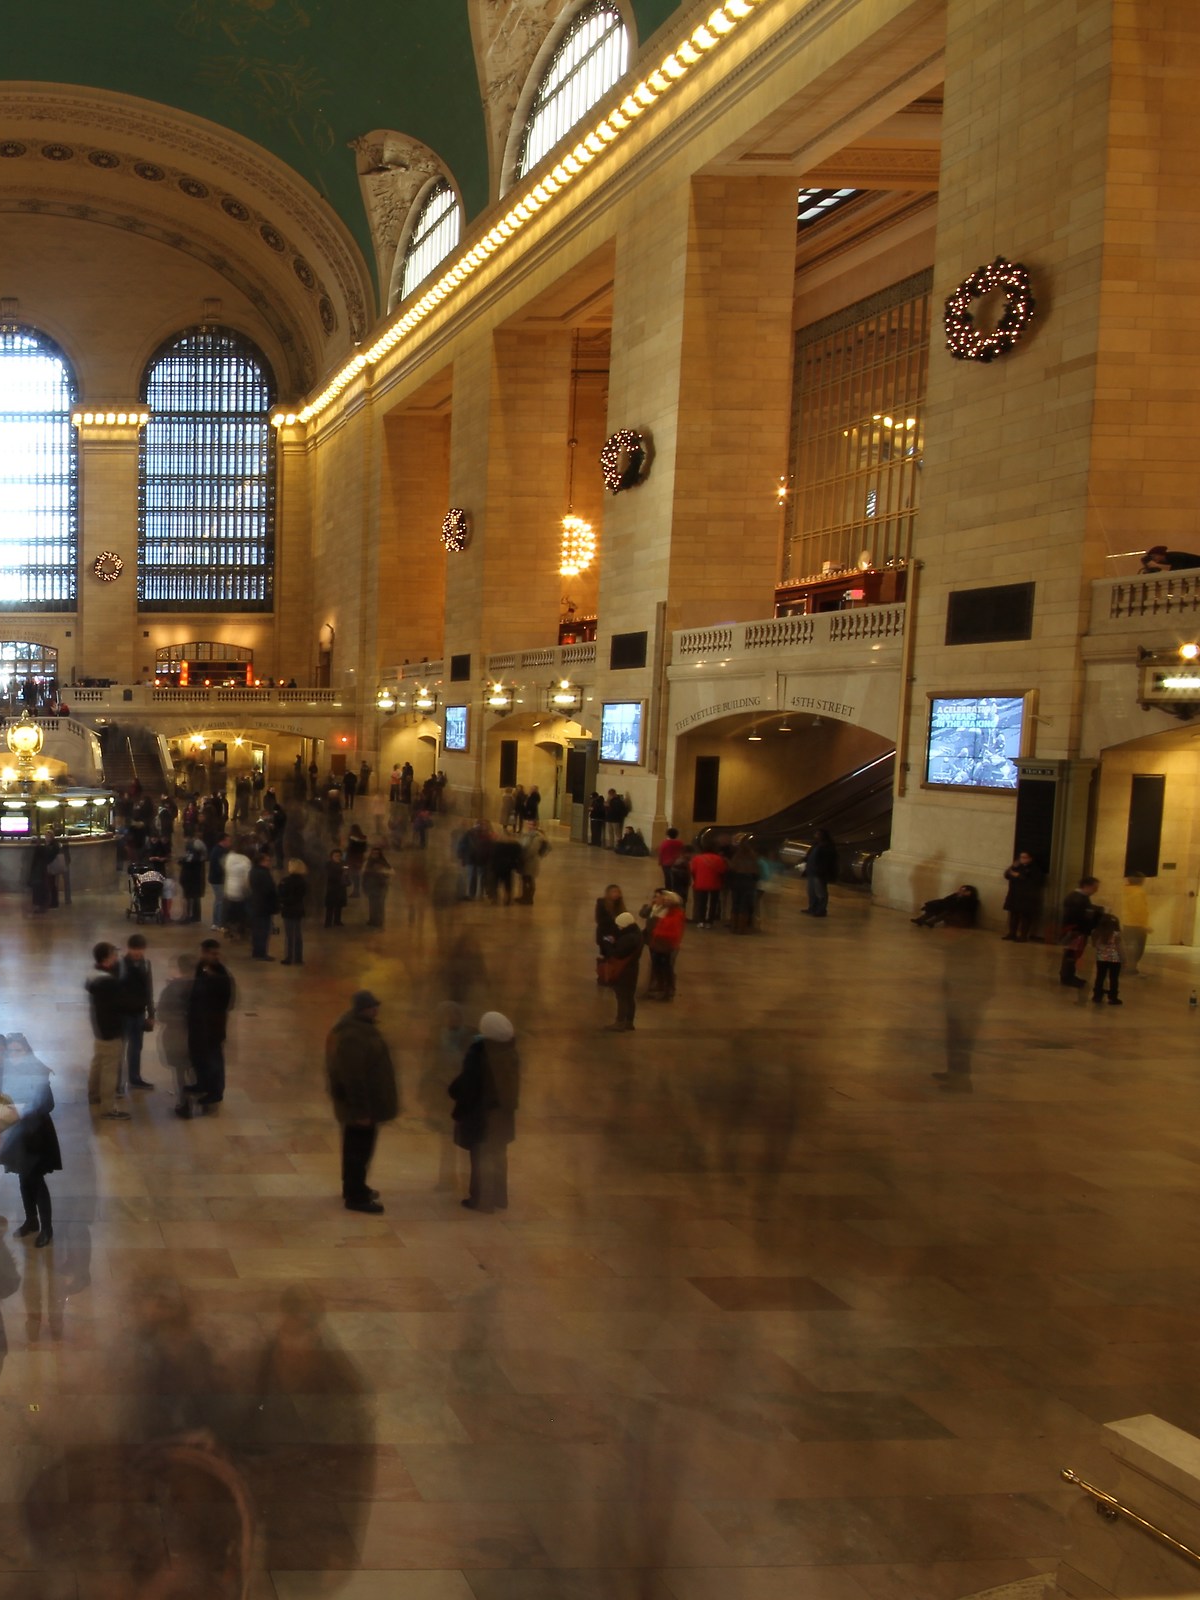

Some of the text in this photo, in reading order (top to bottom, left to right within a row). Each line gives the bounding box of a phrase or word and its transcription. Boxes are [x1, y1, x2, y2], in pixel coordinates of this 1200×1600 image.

[674, 697, 761, 731] THE METLIFE BUILDING
[790, 696, 855, 717] 45TH STREET
